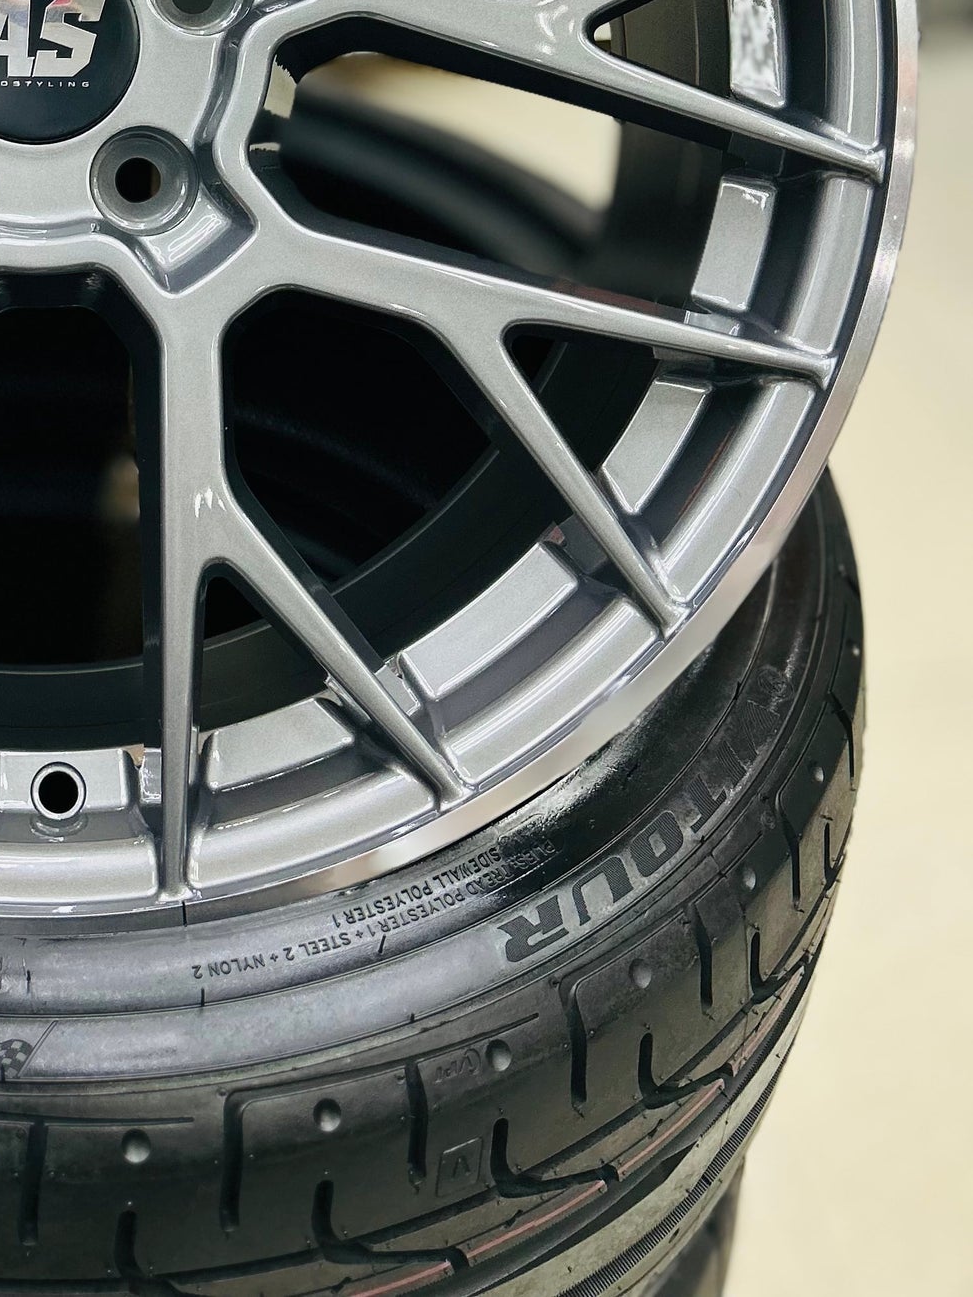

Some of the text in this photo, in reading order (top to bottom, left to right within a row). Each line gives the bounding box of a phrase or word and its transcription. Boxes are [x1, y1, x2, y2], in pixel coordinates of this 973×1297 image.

[330, 846, 502, 929] SIDEWALL POLYESTER 1
[463, 862, 515, 897] TREAD
[377, 887, 465, 933] POLYESTER
[281, 945, 295, 962] 2
[297, 930, 350, 957] STEEL
[190, 963, 204, 980] 2
[206, 951, 265, 978] NYLON
